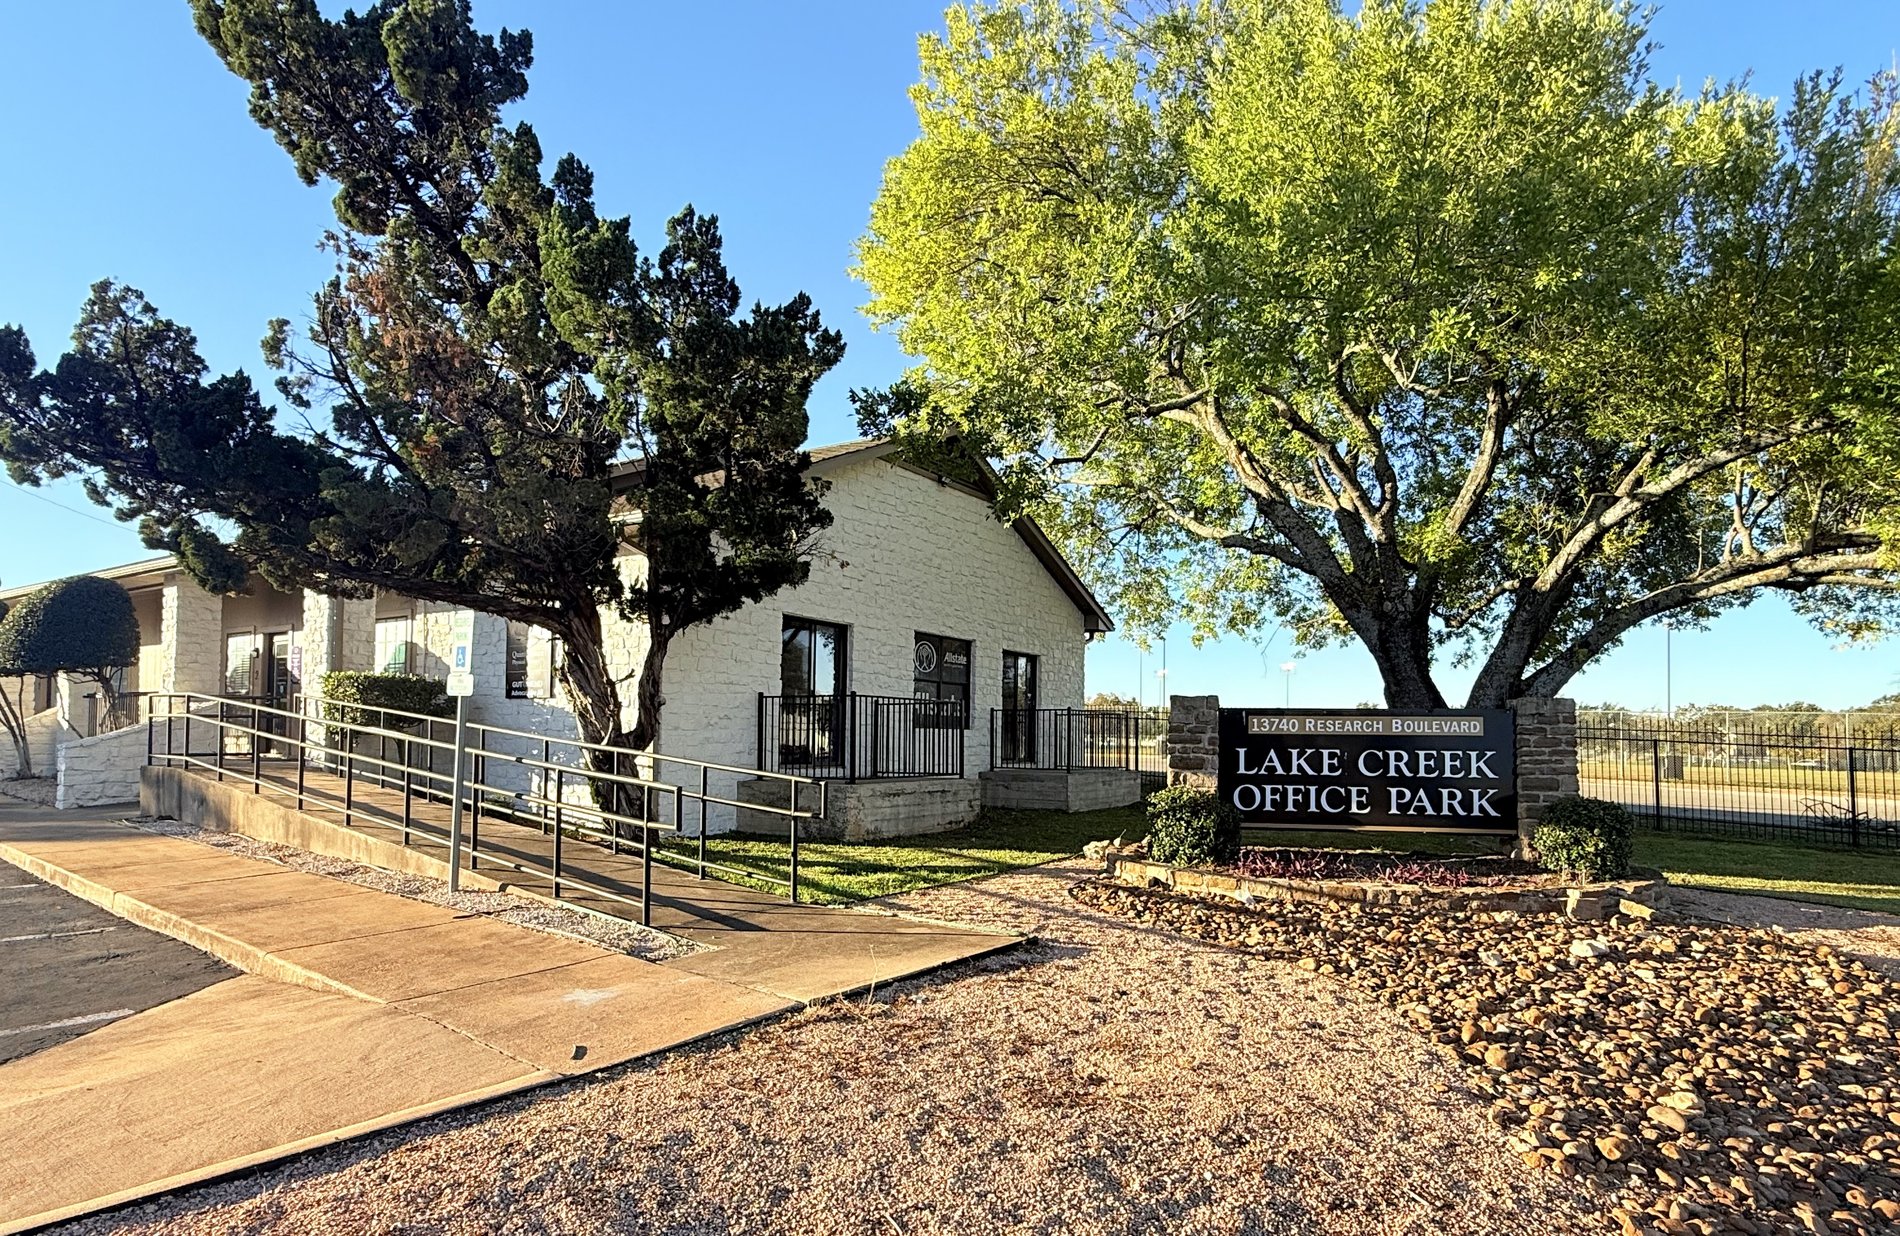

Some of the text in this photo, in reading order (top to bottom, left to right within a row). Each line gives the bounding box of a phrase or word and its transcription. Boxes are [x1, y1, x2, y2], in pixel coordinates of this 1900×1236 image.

[943, 652, 967, 665] Allstate
[1252, 718, 1481, 734] 13740 RESEARCH BOULEVARD
[1235, 748, 1499, 779] LAKE CREEK
[1232, 784, 1501, 817] OFFICE PARK
